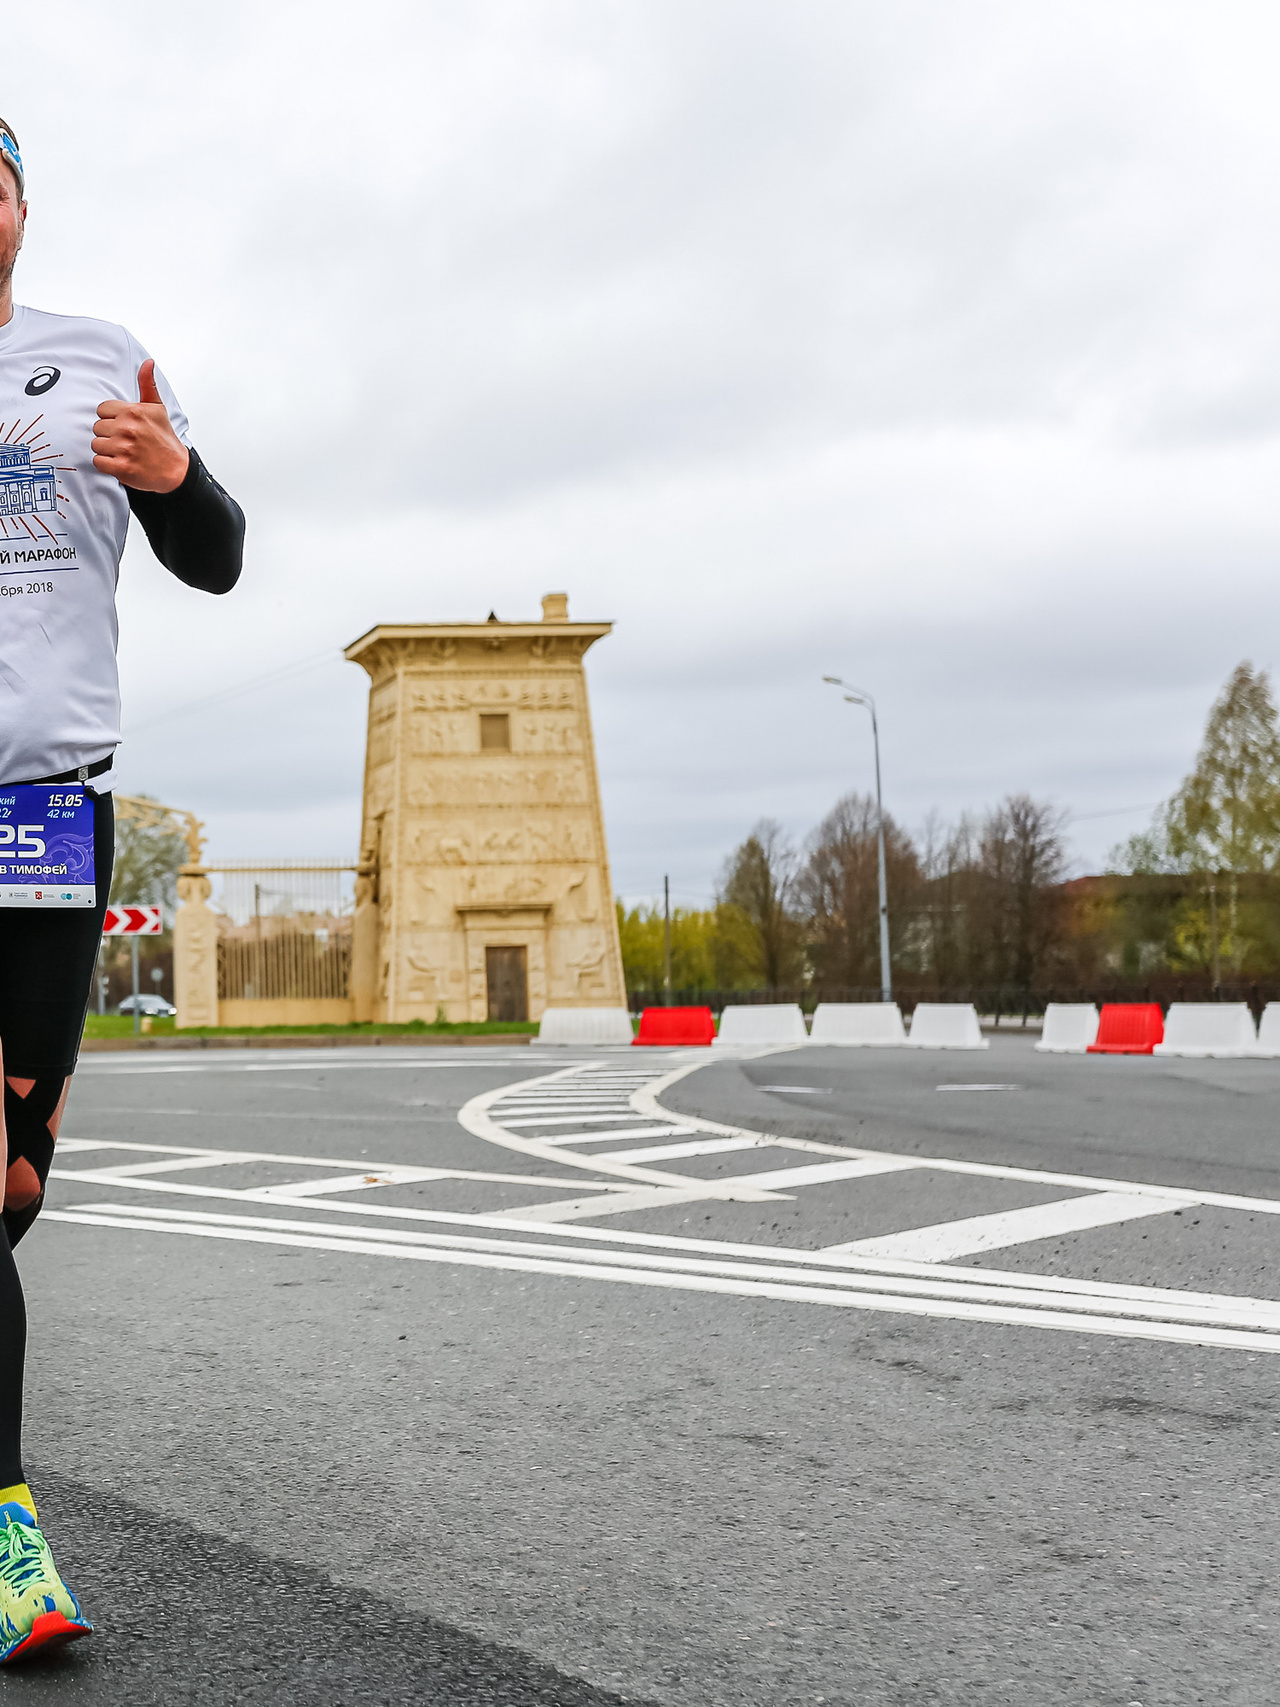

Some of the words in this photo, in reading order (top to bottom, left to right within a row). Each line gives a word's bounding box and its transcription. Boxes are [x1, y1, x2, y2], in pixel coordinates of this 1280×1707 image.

[15, 547, 77, 563] МАРАФОН
[27, 582, 53, 594] 2018
[47, 794, 84, 807] 15.05
[46, 809, 60, 819] 42
[9, 863, 68, 875] ТИМОФЕЙ
